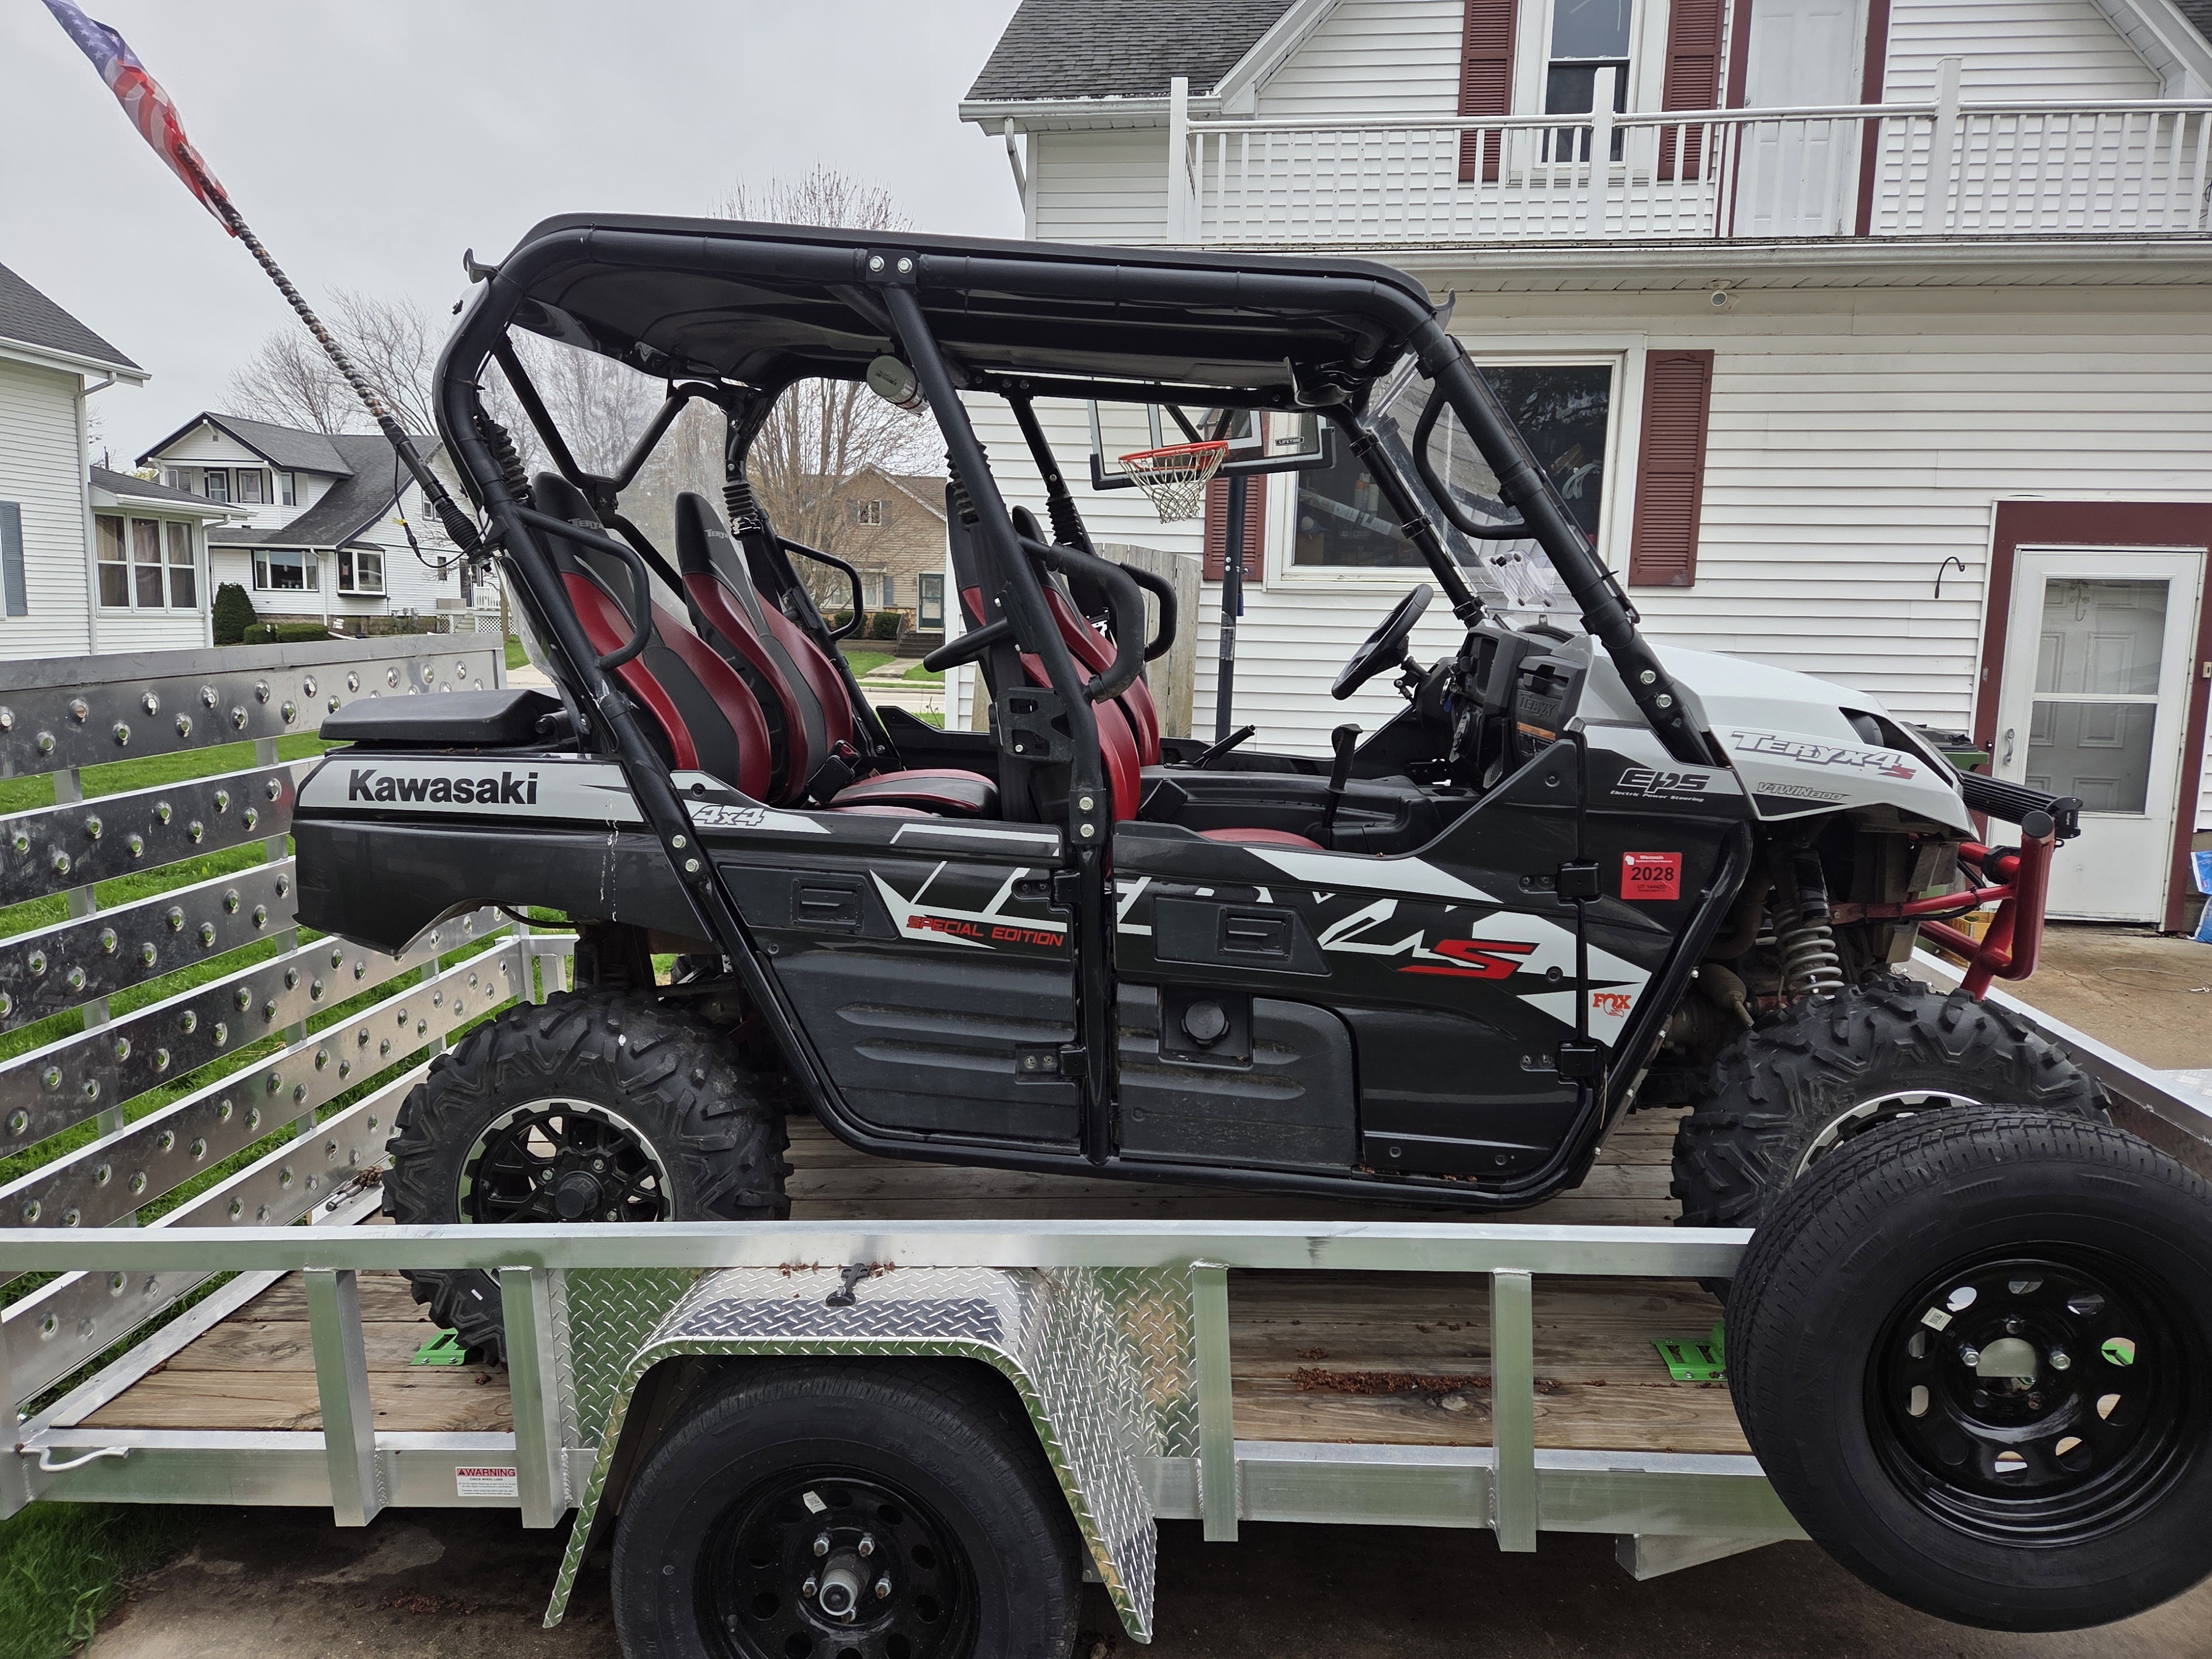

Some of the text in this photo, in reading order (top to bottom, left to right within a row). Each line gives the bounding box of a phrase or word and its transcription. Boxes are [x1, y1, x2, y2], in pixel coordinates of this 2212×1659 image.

[348, 769, 539, 805] Kawasaki
[1617, 768, 1711, 794] EPS
[692, 805, 765, 826] 4x4
[1630, 867, 1674, 881] 2028
[906, 915, 1063, 946] SPECIAL EDITION
[1593, 993, 1631, 1018] FOX
